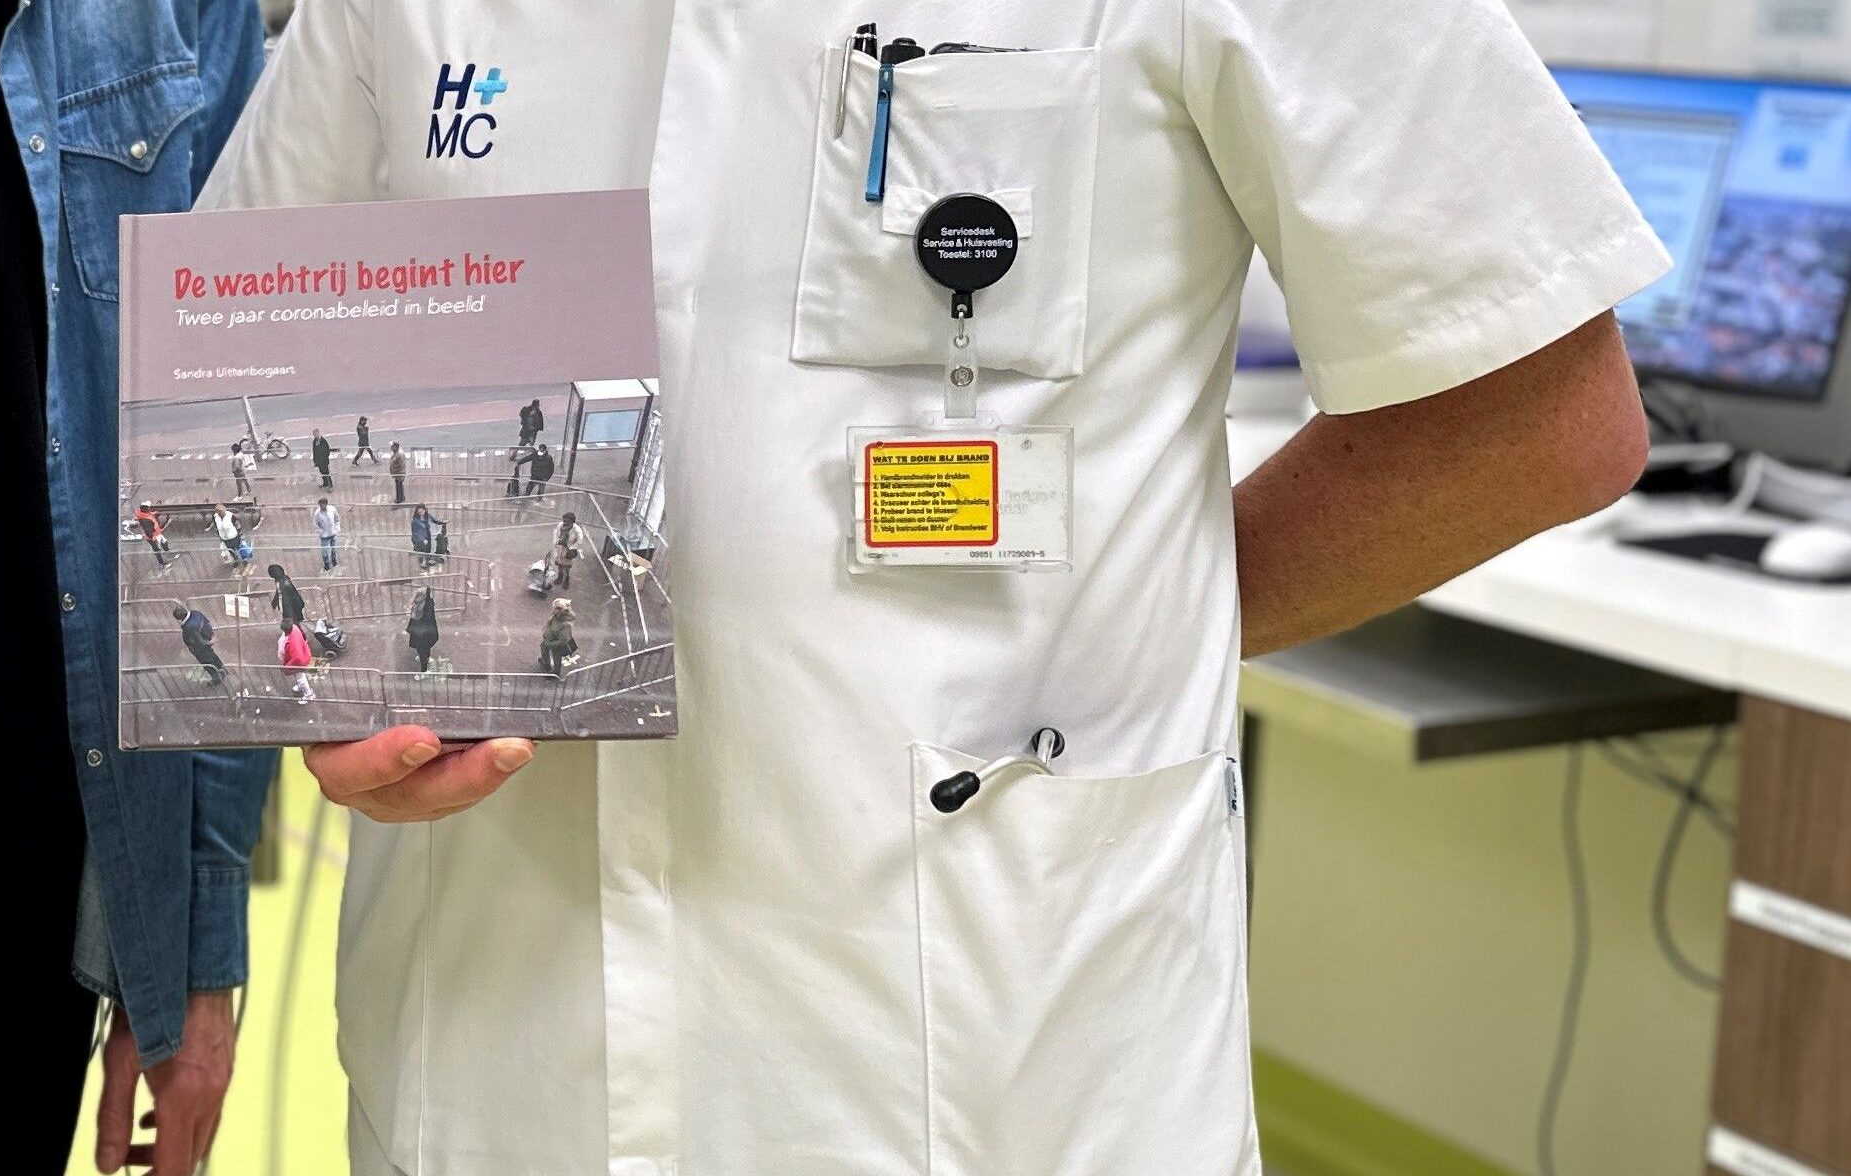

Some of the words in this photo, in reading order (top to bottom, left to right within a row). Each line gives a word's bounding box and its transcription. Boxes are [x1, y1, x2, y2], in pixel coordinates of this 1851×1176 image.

[426, 113, 496, 158] MC
[941, 227, 995, 236] Servicedesk
[923, 239, 954, 247] Service
[956, 239, 962, 247] &
[964, 238, 1013, 248] Huisvesting
[975, 249, 997, 258] 3100
[173, 267, 206, 300] De
[214, 261, 347, 298] wachtrij
[357, 258, 455, 295] begint
[464, 252, 525, 286] hier
[176, 309, 224, 326] Twee
[227, 307, 265, 328] jaar
[270, 299, 398, 322] coronabeleid
[404, 299, 422, 315] in
[427, 295, 486, 314] beeld
[173, 368, 212, 379] Sandra
